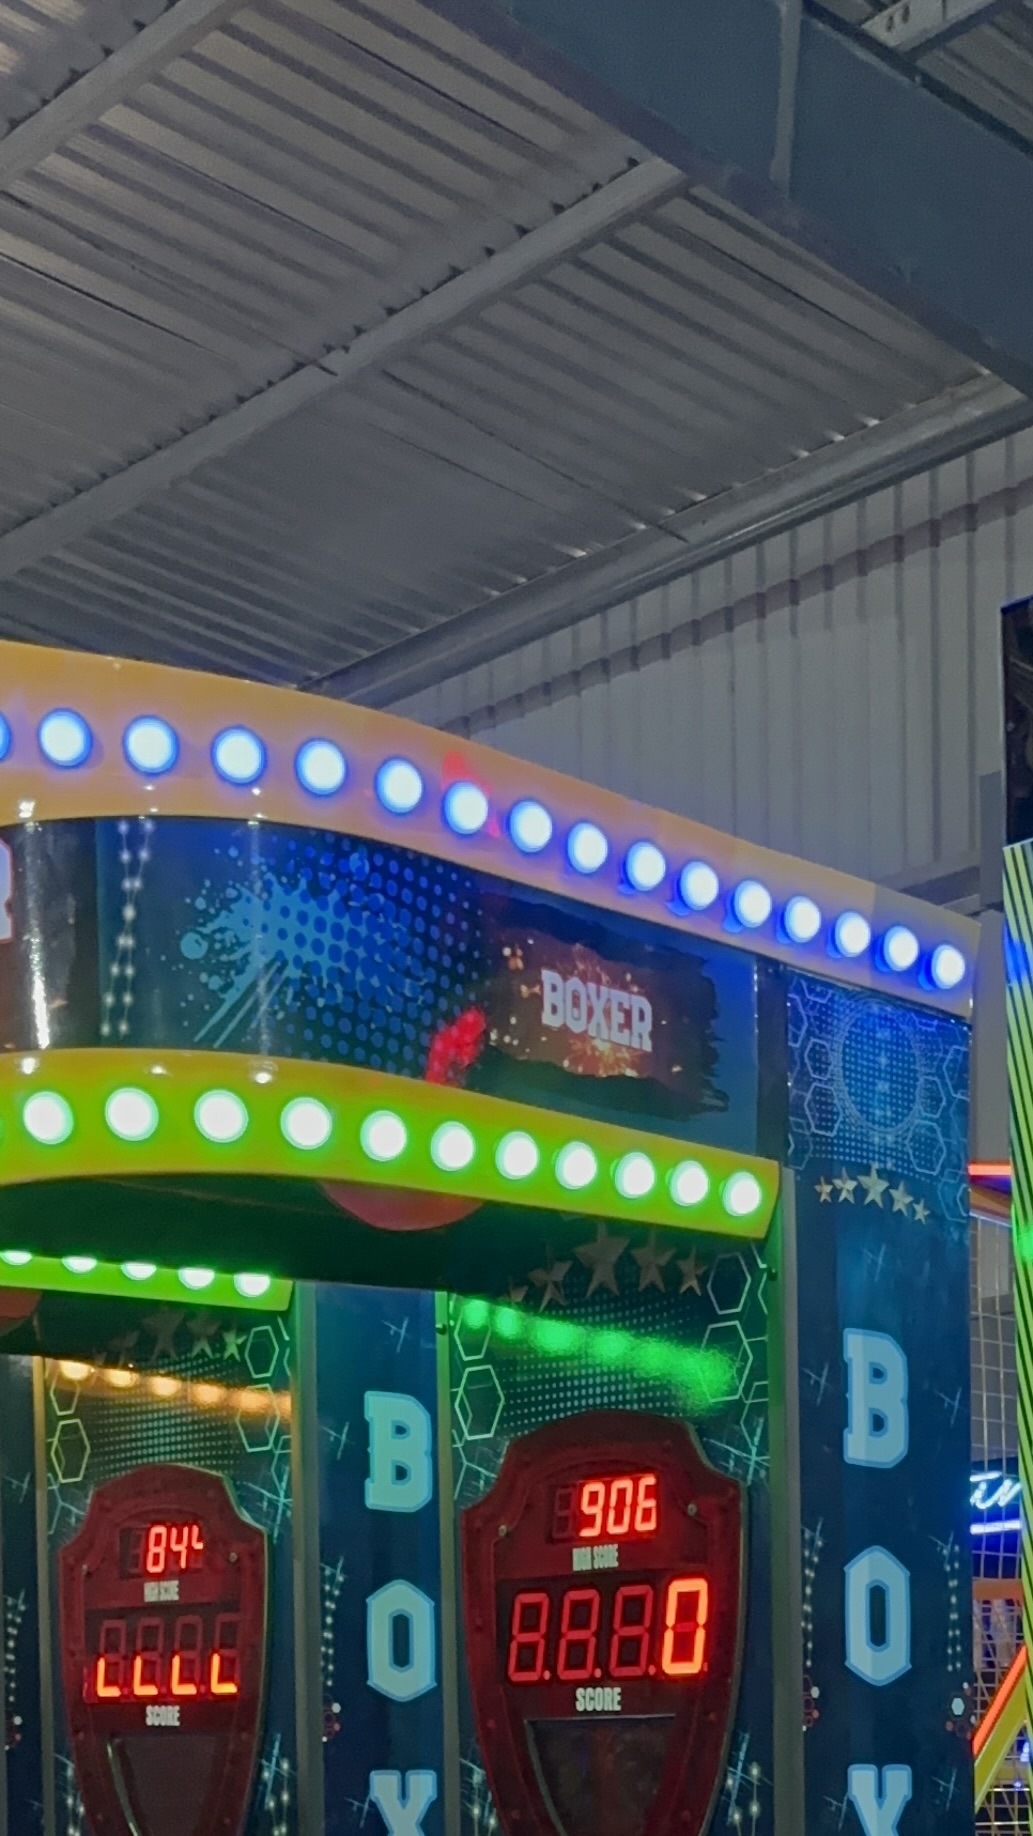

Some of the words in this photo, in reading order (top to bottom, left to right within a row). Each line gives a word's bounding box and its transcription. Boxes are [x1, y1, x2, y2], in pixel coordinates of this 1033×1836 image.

[541, 968, 653, 1052] BOXER
[579, 1473, 657, 1537] 906
[145, 1705, 181, 1726] SCORE
[575, 1687, 622, 1712] SCORE
